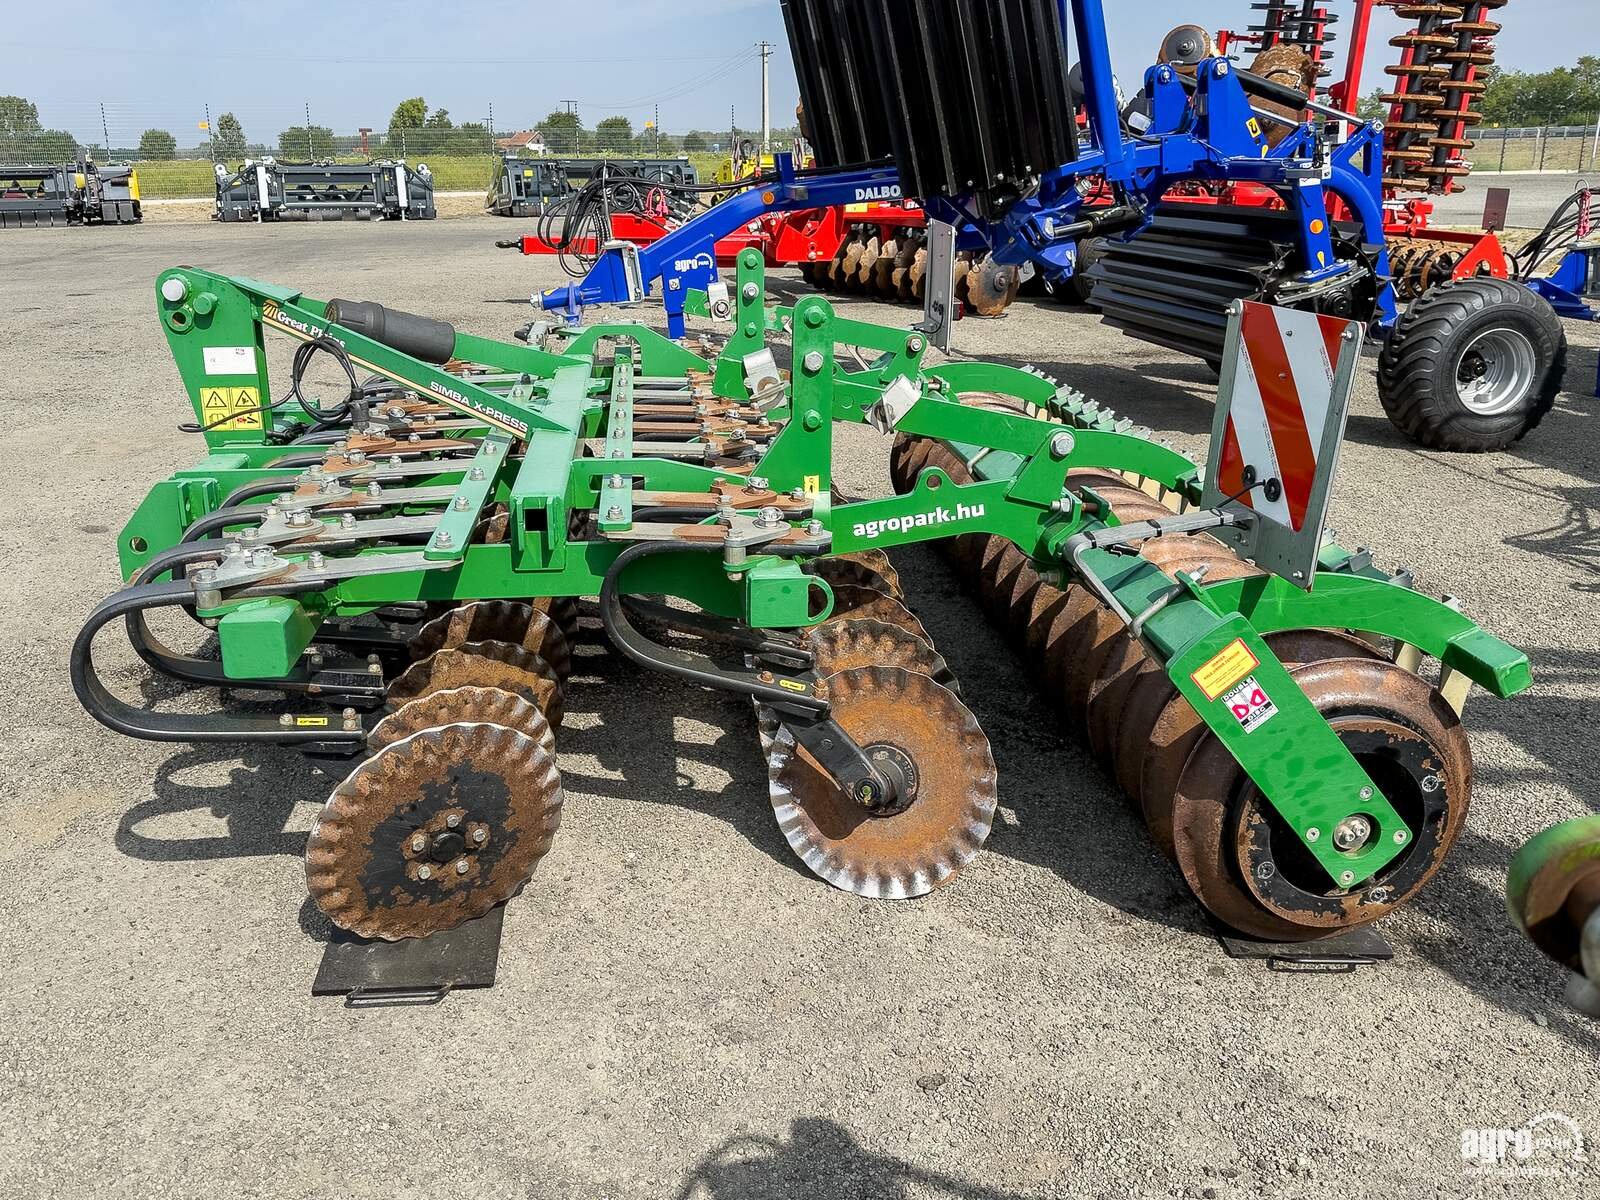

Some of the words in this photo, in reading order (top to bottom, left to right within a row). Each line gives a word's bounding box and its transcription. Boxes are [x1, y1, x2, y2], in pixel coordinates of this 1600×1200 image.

[855, 184, 901, 201] DALBO
[674, 258, 698, 272] agro
[277, 311, 308, 333] Great
[430, 381, 470, 406] SIMBA
[474, 401, 529, 433] X-PRESS
[853, 503, 985, 538] agropark.hu
[1223, 677, 1253, 701] DOUBLE
[1247, 706, 1266, 721] DISC
